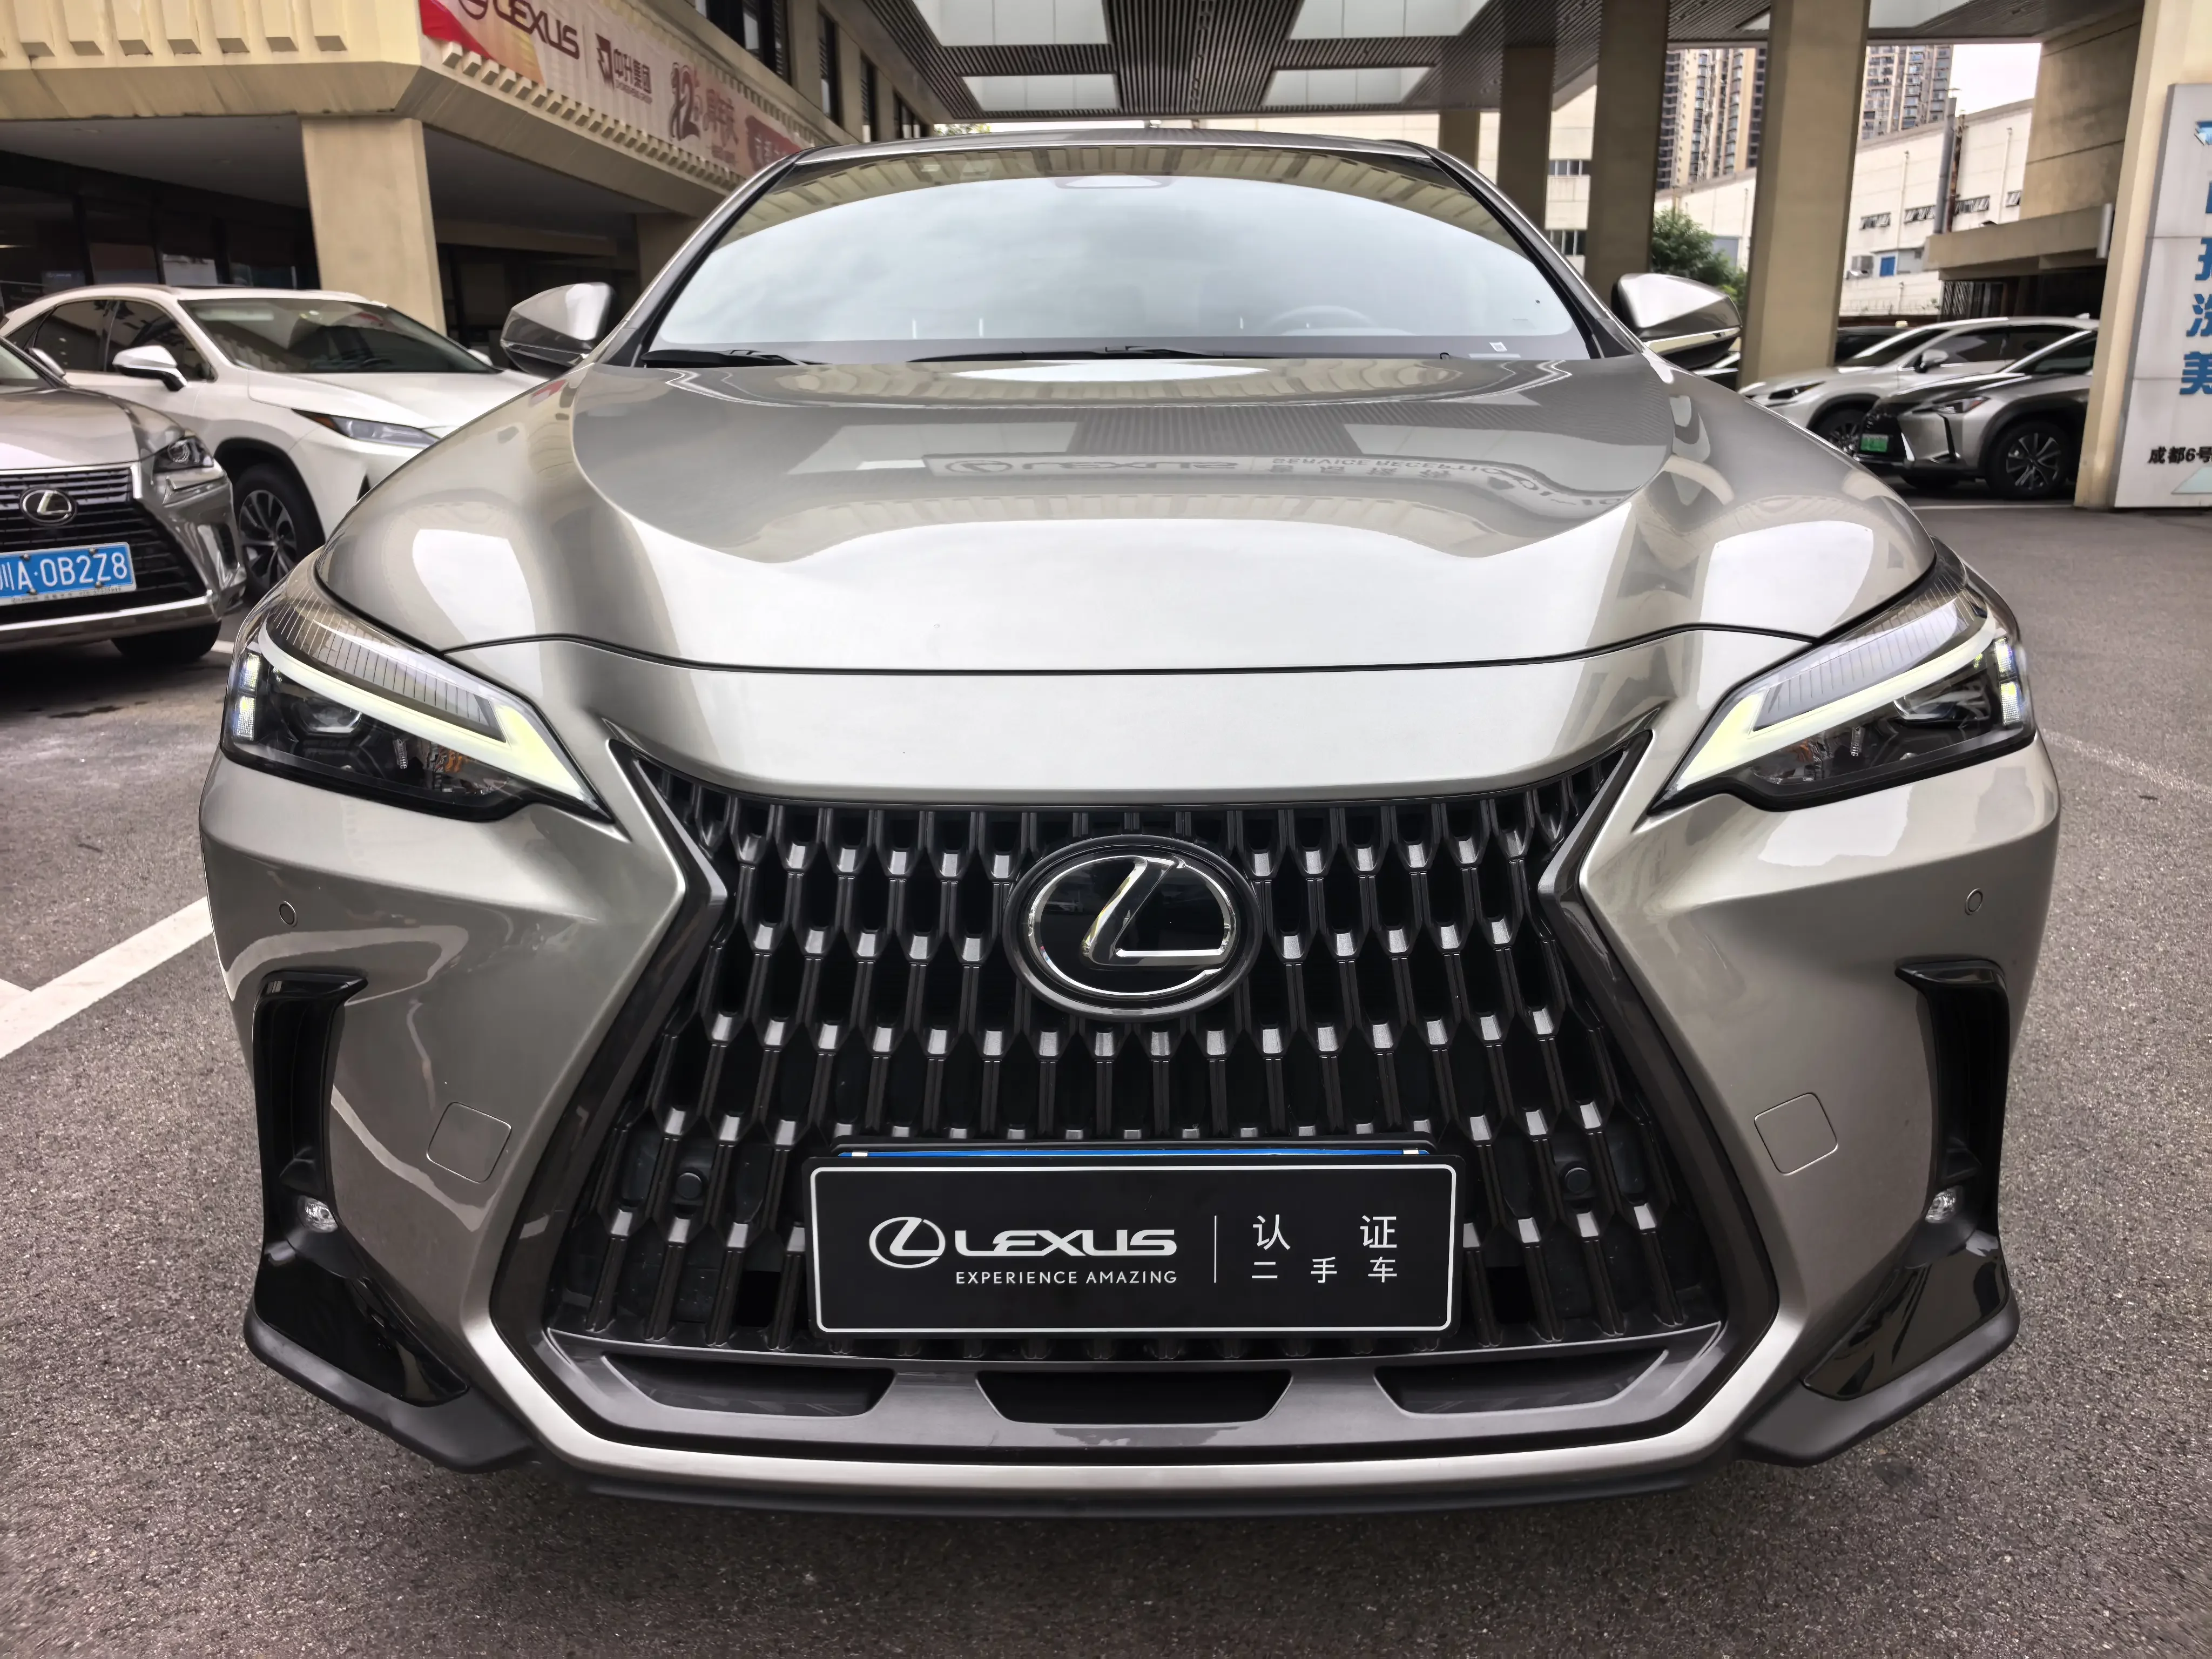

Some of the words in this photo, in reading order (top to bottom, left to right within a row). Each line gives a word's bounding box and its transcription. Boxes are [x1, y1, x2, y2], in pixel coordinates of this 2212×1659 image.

[492, 0, 580, 60] LEXUS
[955, 1229, 1177, 1257] LEXUS
[1252, 1214, 1398, 1250] 认证
[956, 1271, 1077, 1284] EXPERIENCE
[1085, 1270, 1177, 1284] AMAZING
[1251, 1256, 1398, 1283] 二手车
